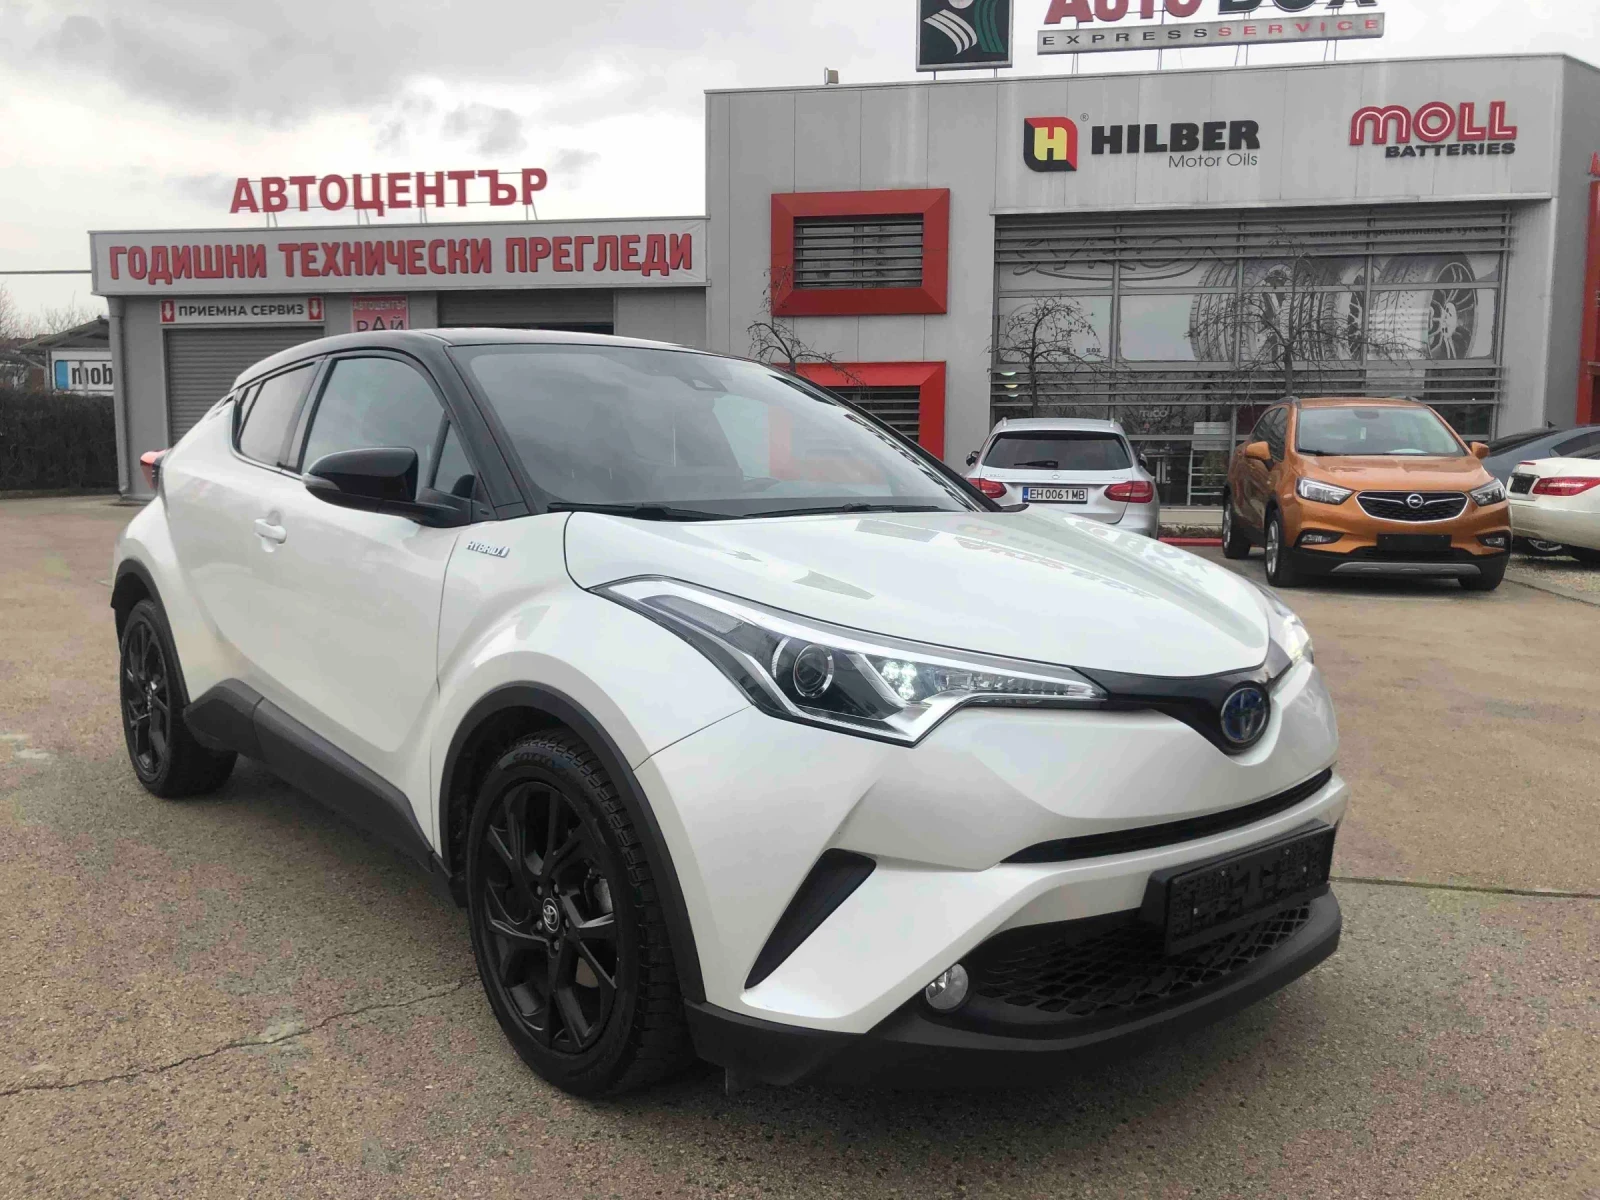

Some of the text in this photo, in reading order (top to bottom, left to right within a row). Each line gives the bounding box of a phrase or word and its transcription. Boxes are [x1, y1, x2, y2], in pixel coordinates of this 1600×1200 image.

[1042, 19, 1379, 46] EXPRESS SERVICE
[1091, 120, 1260, 155] HILBER
[1168, 152, 1258, 168] Motor Oils
[1385, 143, 1516, 158] BATTERIES
[229, 168, 547, 217] АВТОЦЕНТЪР
[109, 233, 692, 285] ГОДИШНИ ТЕХНИЧЕСКИ ПРЕГЛЕДИ
[178, 303, 304, 317] ПРИЕМНА СЕРВИЗ
[1029, 488, 1086, 500] EH 0061 MB
